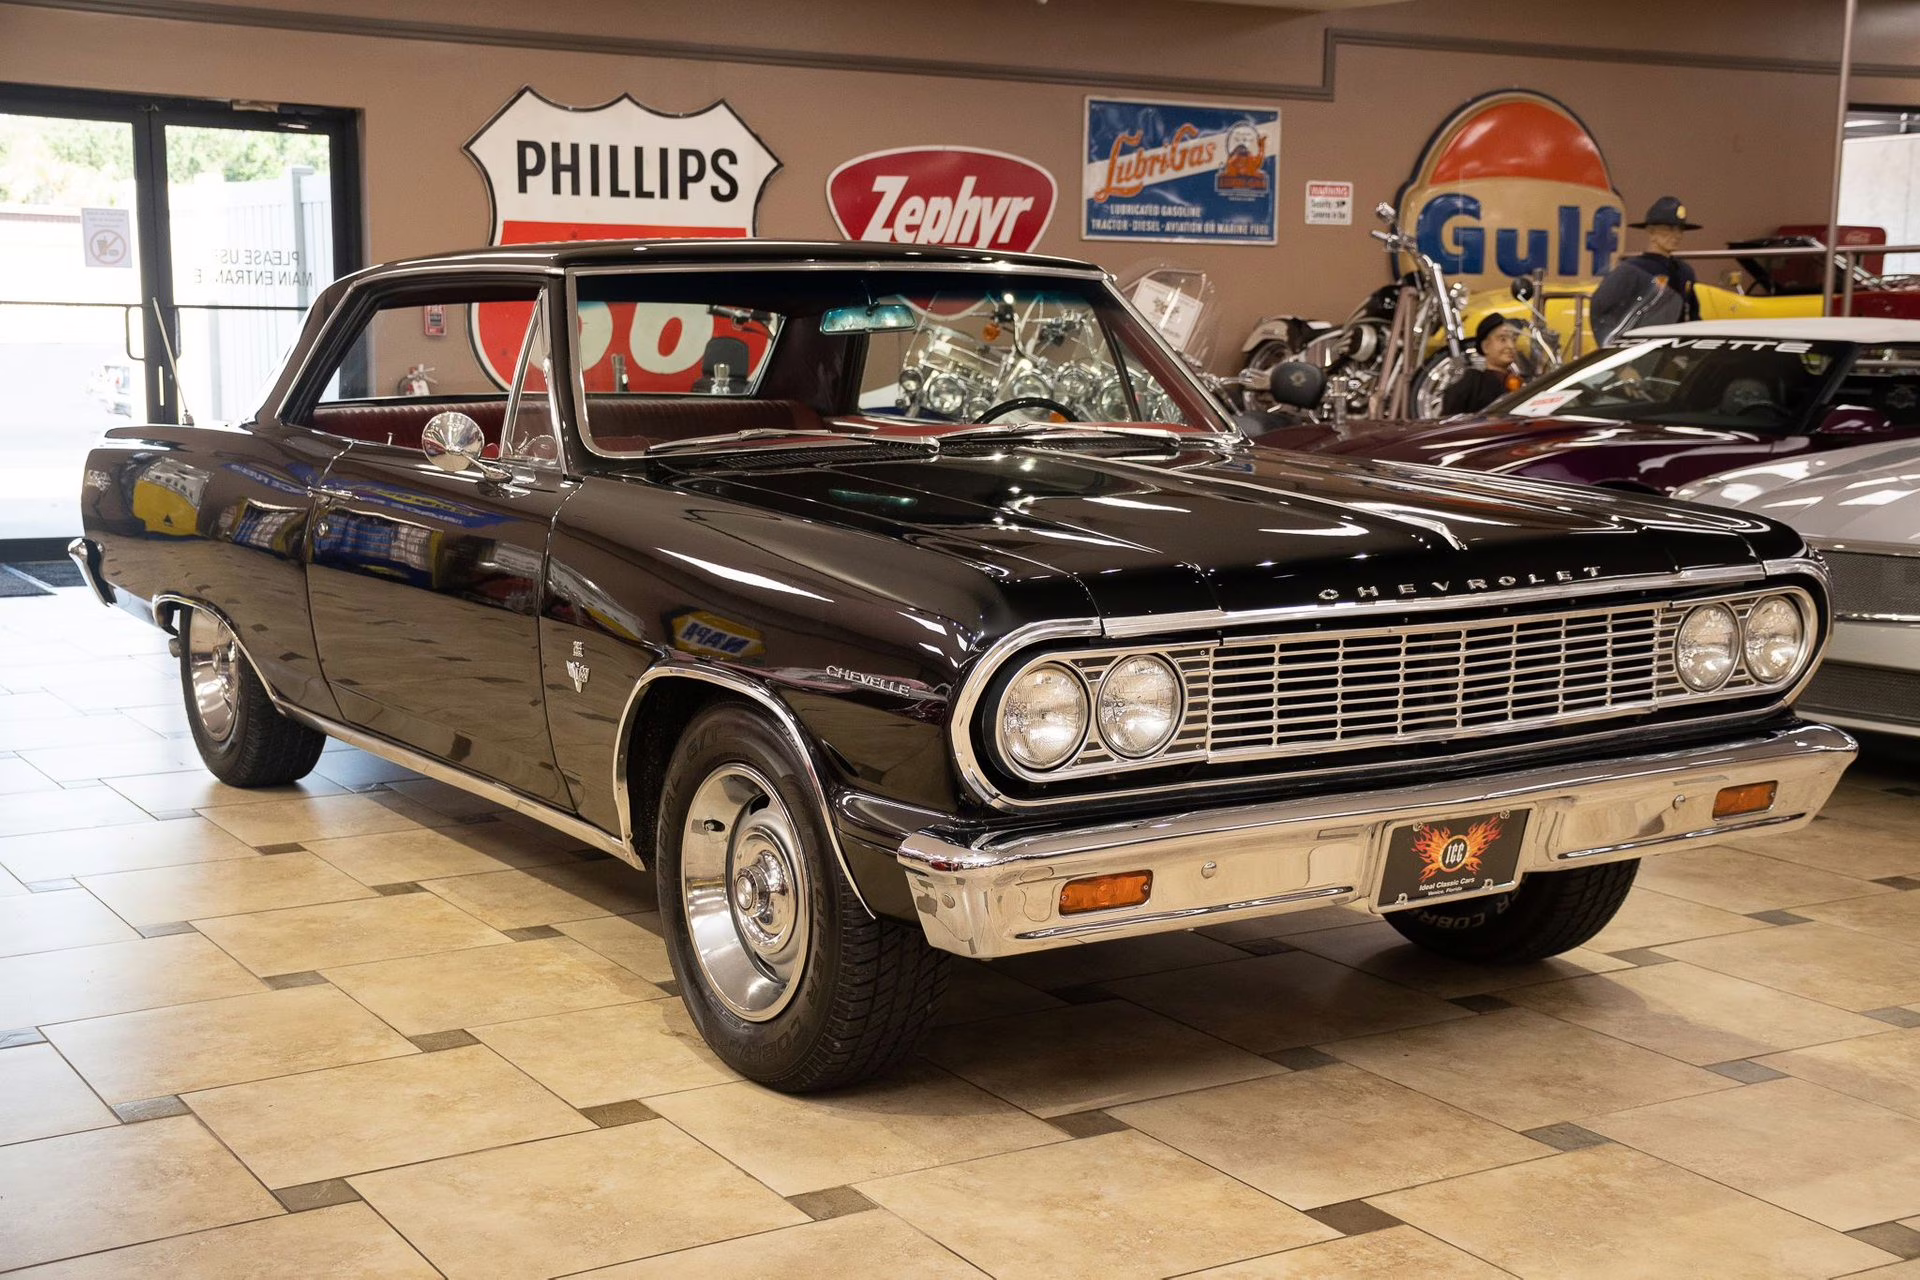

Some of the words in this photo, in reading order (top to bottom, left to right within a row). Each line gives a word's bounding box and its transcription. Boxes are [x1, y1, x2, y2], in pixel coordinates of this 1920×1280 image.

[516, 139, 739, 202] PHILLIPS
[1310, 185, 1348, 197] WARNING
[861, 175, 1035, 249] Zephyr
[1110, 203, 1160, 217] LUBRICATED
[1161, 205, 1202, 218] GASOLINE
[1091, 218, 1128, 231] TRACTOR
[1132, 219, 1160, 232] DIESEL
[1165, 221, 1202, 233] AVIATION
[1204, 222, 1215, 233] OR
[1217, 223, 1248, 235] MARINE
[1250, 224, 1270, 236] FUEL
[1416, 192, 1622, 278] Gulf
[1602, 338, 1813, 354] COVETTE
[1318, 565, 1601, 601] CHEVROLET
[826, 665, 911, 697] CHEVELLE
[1445, 842, 1465, 865] ICC
[1419, 883, 1436, 891] Ideal
[1436, 879, 1460, 889] Classic
[1460, 877, 1476, 885] Cars
